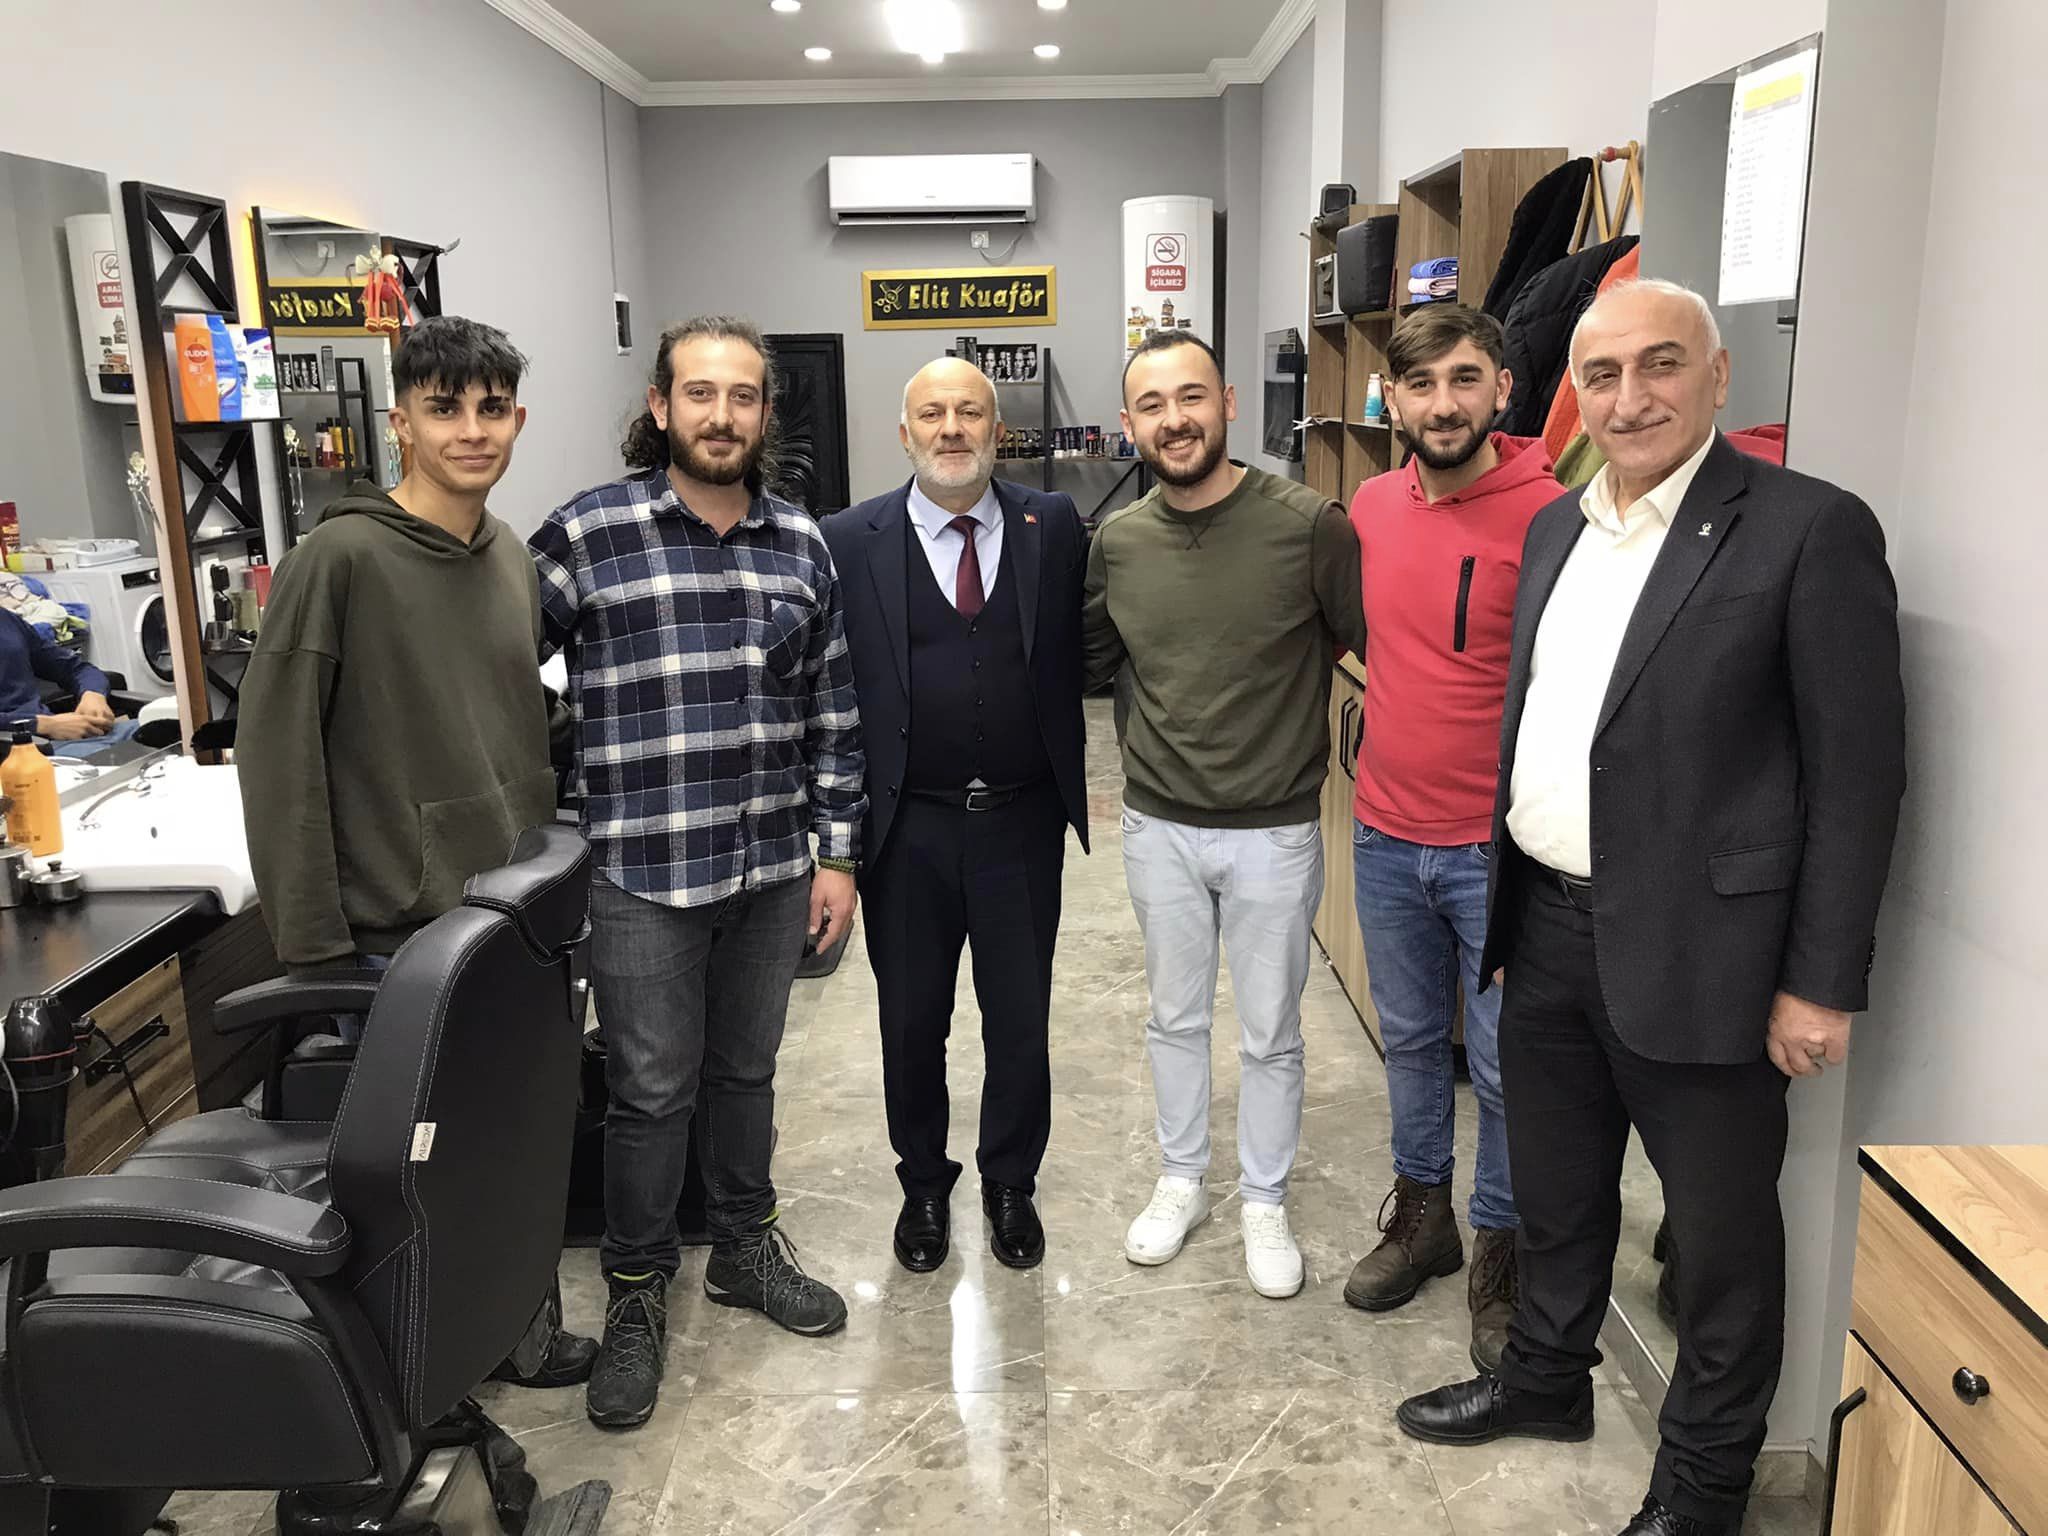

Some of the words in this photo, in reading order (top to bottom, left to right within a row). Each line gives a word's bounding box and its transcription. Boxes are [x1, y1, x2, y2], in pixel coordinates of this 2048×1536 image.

[1151, 268, 1181, 276] SİGARA
[1150, 277, 1183, 287] İÇİLMEZ
[908, 283, 949, 310] Elit
[959, 281, 1045, 313] Kuaför
